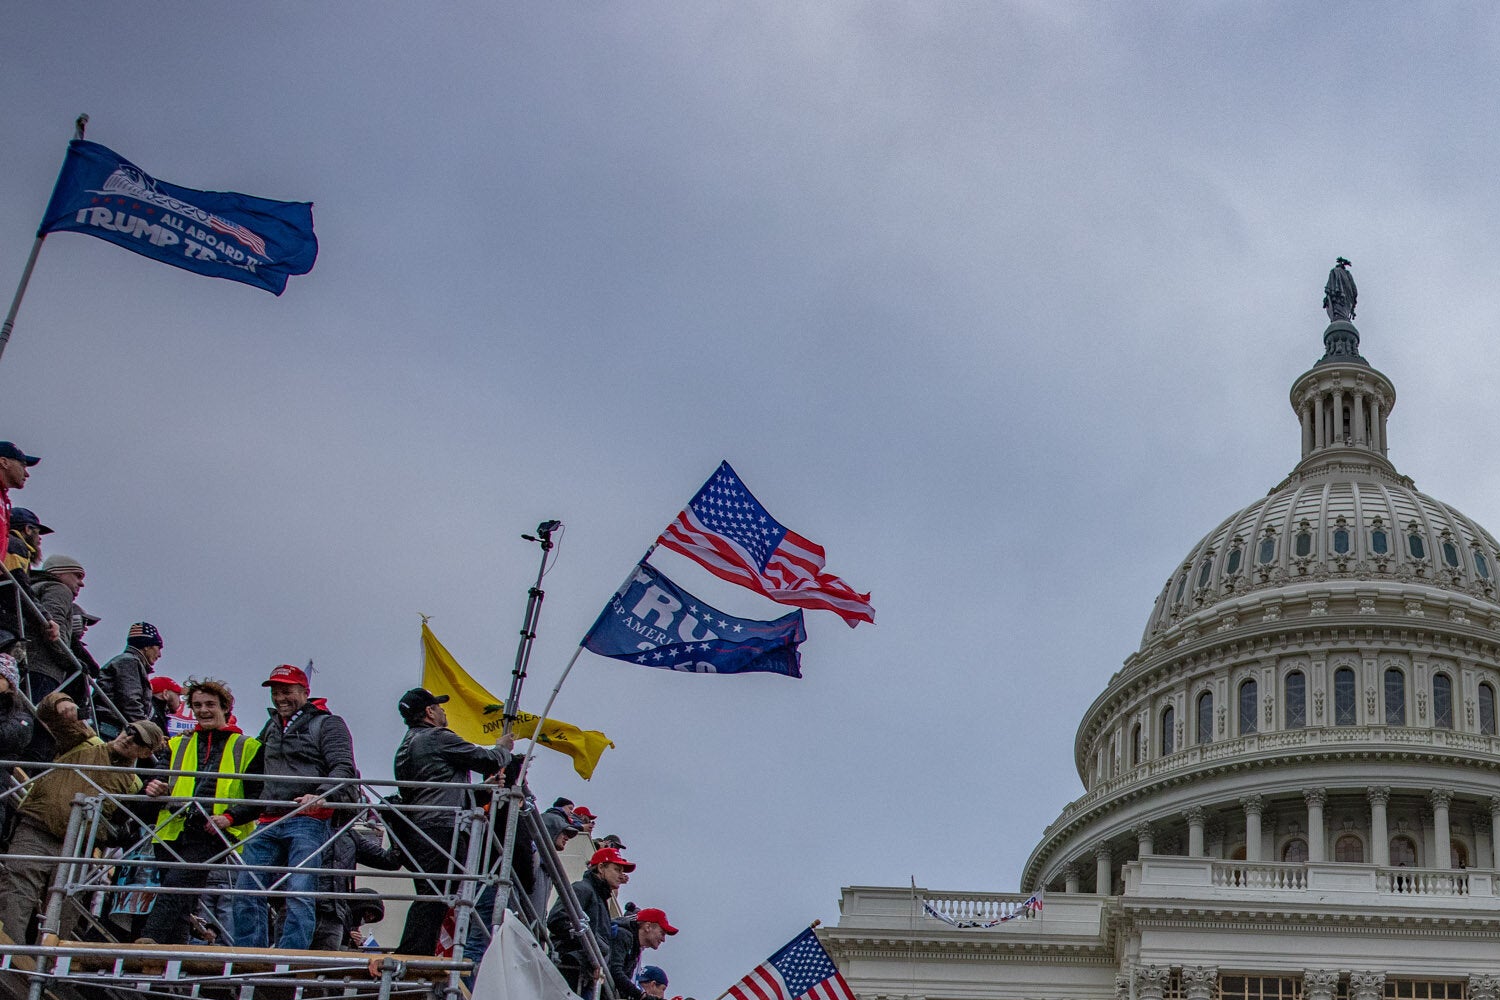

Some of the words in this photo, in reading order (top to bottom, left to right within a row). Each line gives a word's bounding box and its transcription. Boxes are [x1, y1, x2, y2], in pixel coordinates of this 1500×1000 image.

[76, 206, 179, 247] TRUMP
[160, 213, 184, 232] ALL
[186, 225, 244, 261] ABOARD
[622, 616, 674, 646] AMERI
